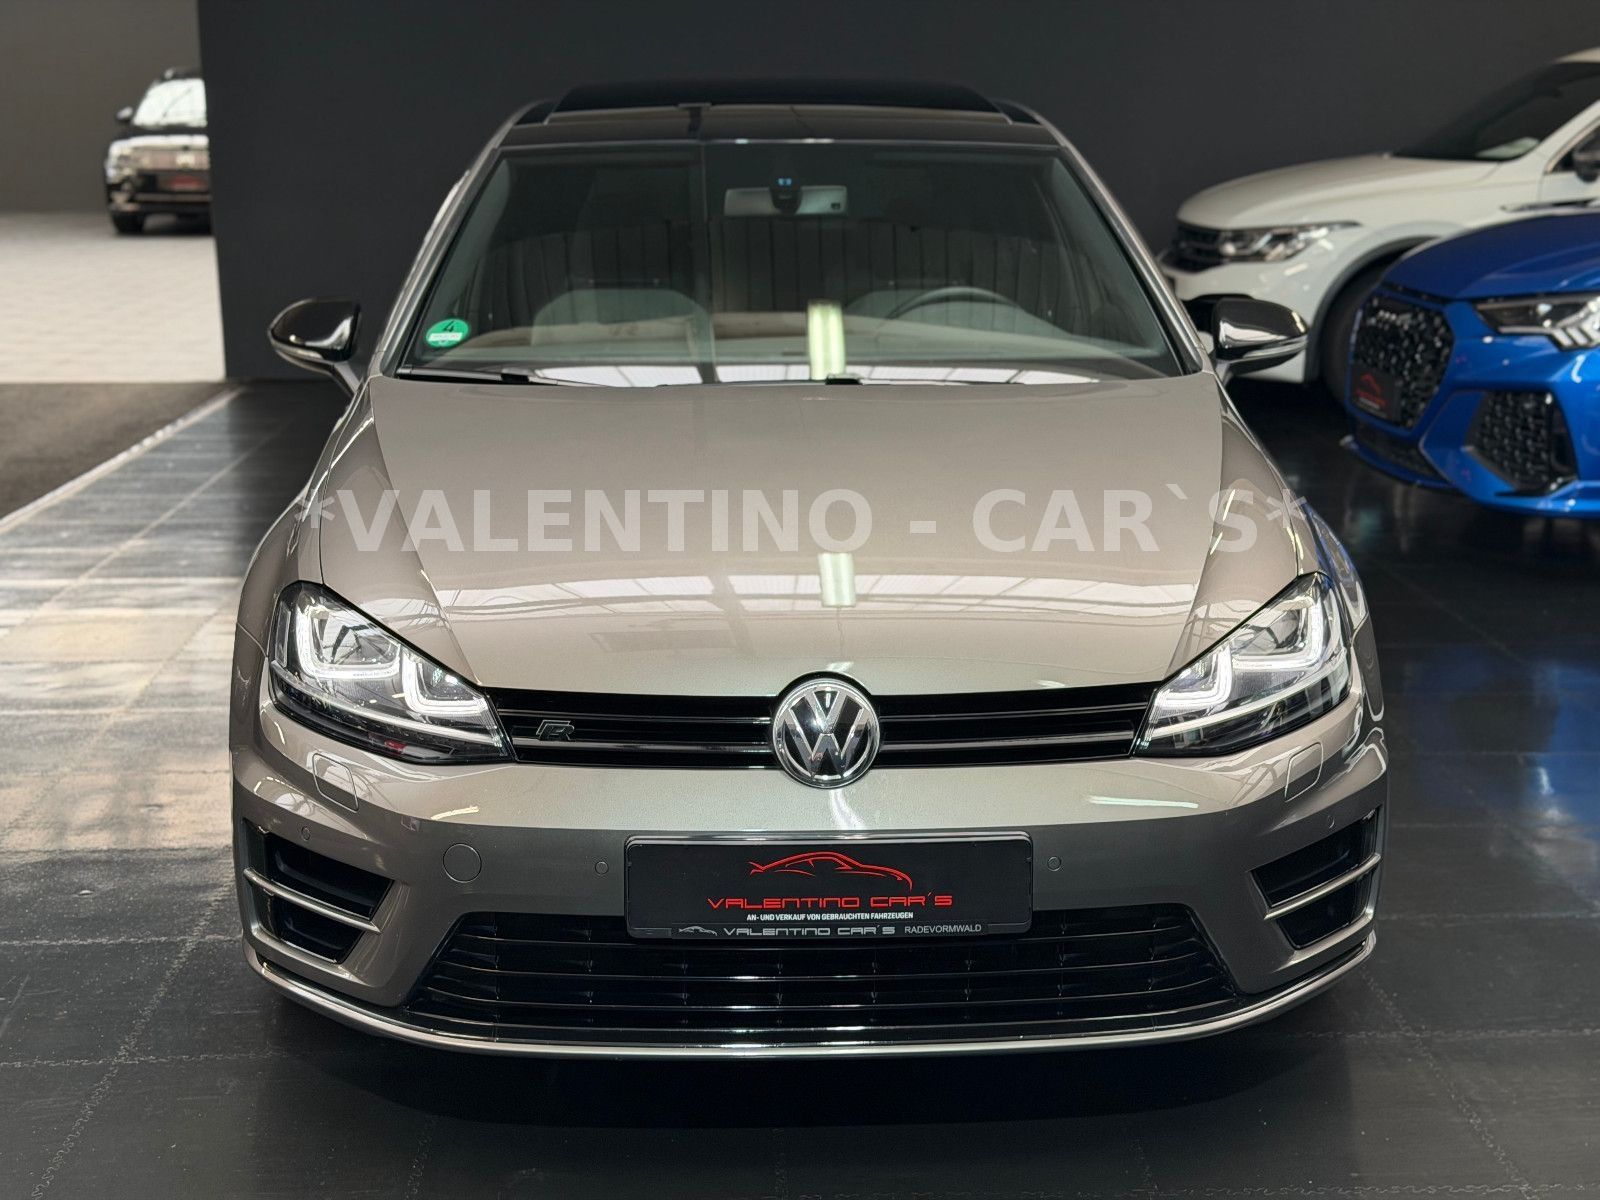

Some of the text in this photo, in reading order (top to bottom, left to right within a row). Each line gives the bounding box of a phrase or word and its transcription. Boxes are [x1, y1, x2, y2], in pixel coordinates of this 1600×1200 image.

[442, 320, 455, 333] 4
[782, 689, 872, 779] VW
[707, 897, 860, 910] VALENTINO
[746, 913, 760, 921] AN-
[760, 913, 775, 921] UND
[775, 913, 806, 921] VERKAUF
[821, 912, 870, 920] GEBRAUCHTEN
[870, 911, 914, 919] FAHRZEUGEN
[723, 927, 831, 936] VALENTINO
[904, 923, 982, 934] RADEVORMWALD
